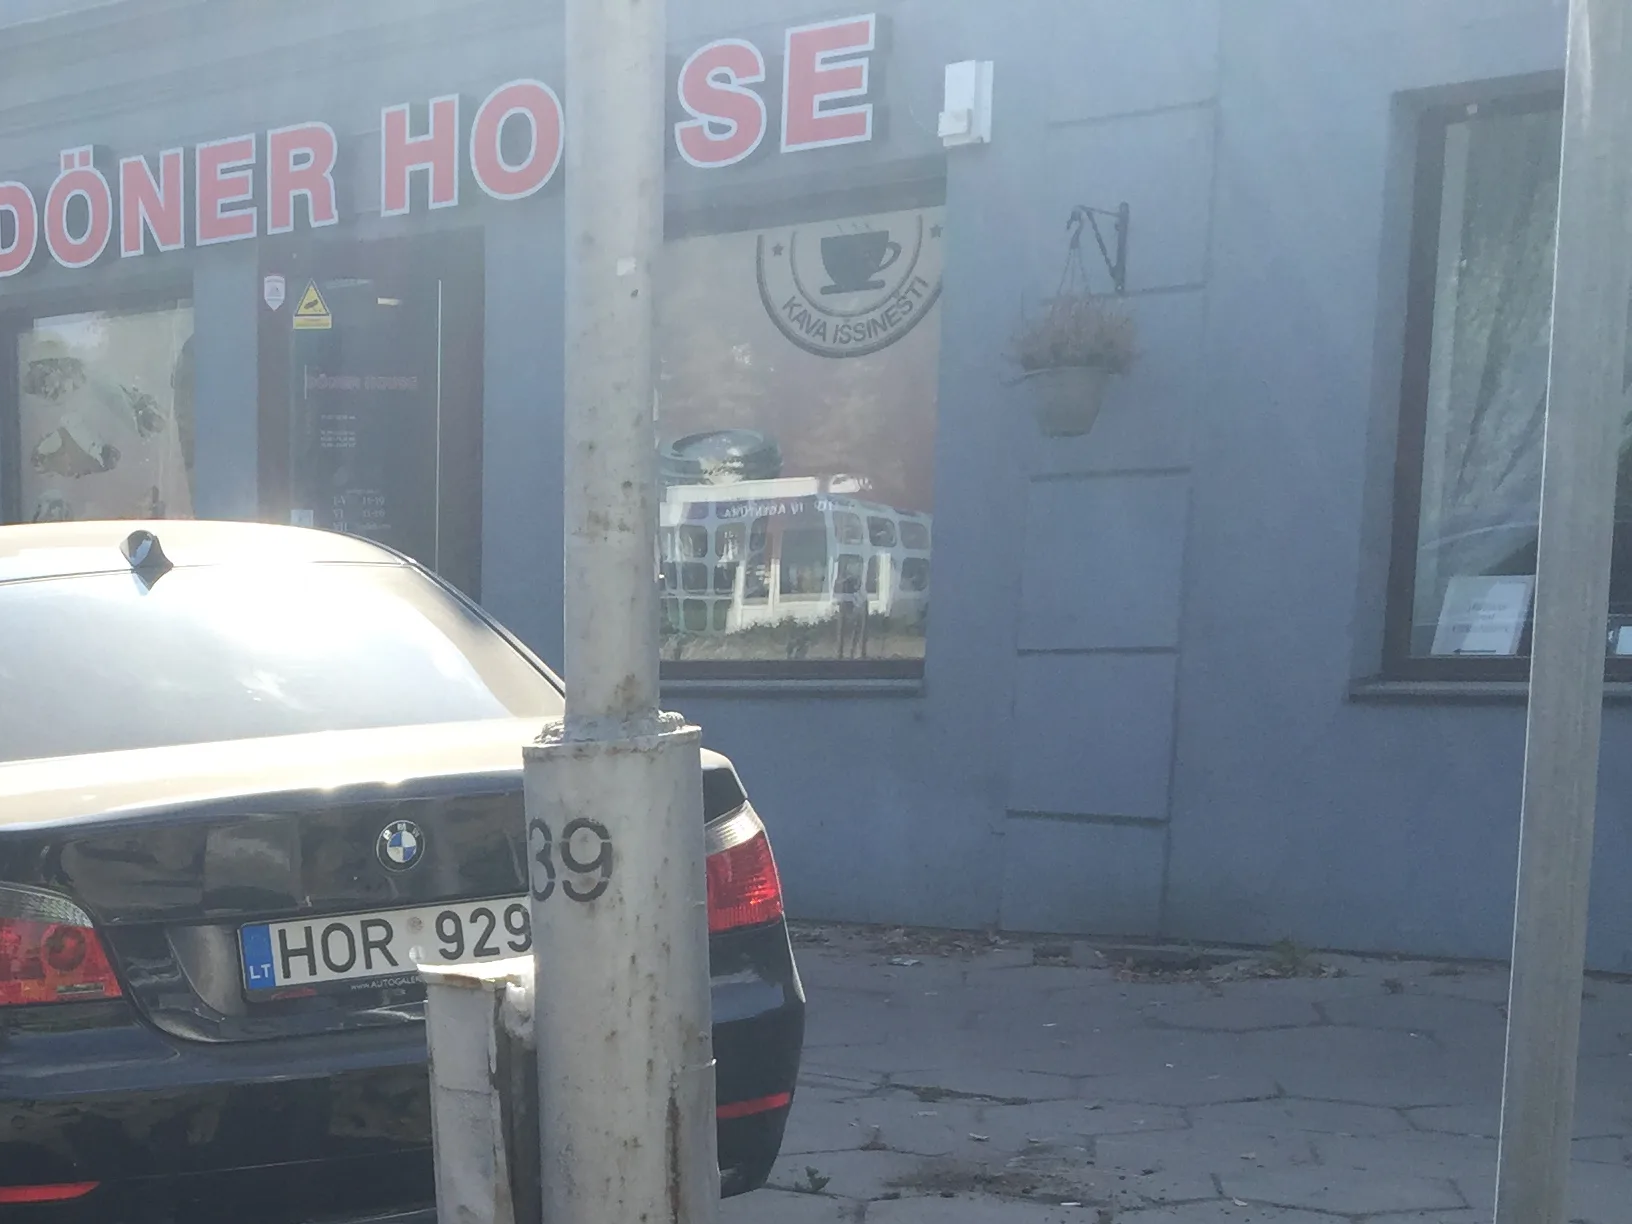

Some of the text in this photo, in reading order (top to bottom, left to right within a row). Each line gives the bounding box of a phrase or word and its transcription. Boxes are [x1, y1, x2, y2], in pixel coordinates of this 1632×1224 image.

[380, 12, 876, 217] HOSE
[782, 295, 827, 342] KAVA
[249, 963, 272, 980] LT
[277, 902, 533, 980] HOR 929
